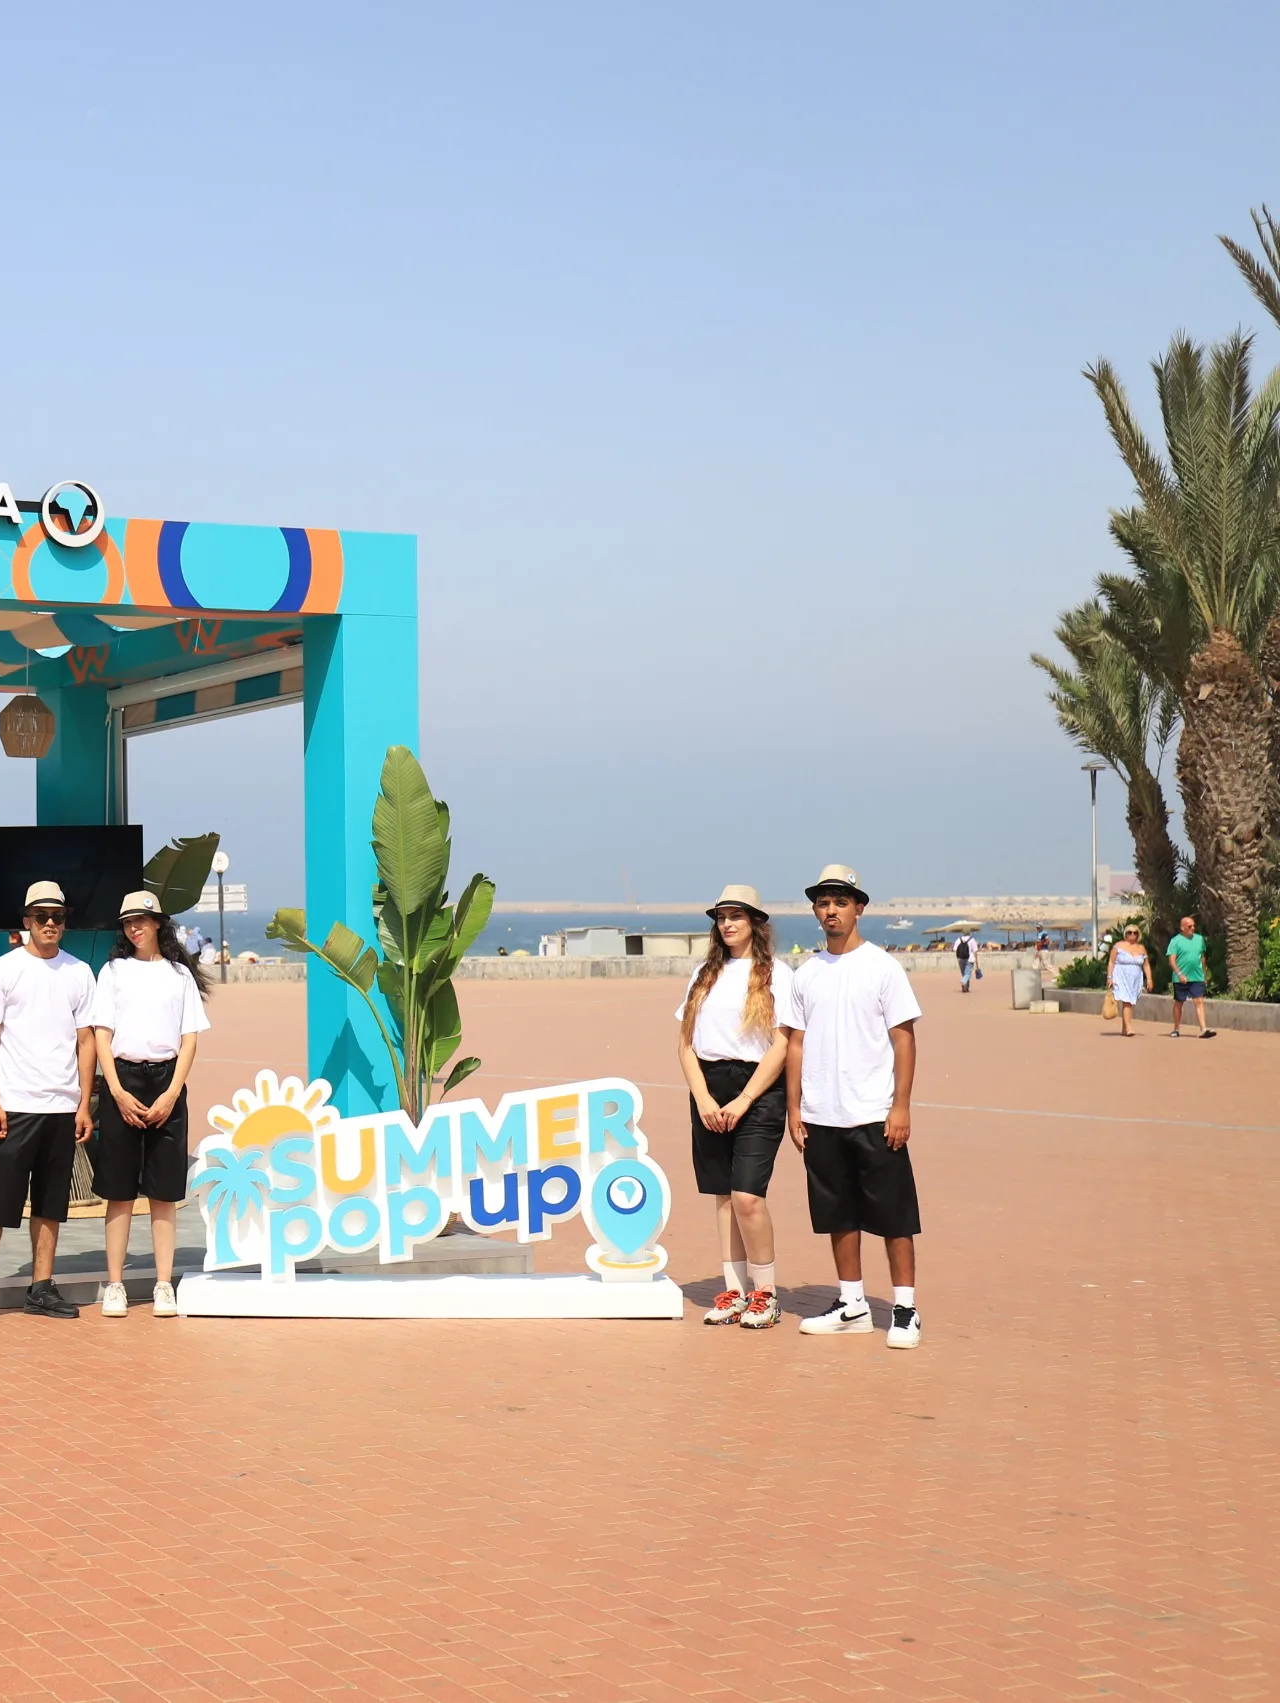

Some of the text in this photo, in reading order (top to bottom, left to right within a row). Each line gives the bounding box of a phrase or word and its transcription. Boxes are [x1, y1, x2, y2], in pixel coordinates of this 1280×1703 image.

[269, 1087, 640, 1203] SUMMER
[269, 1164, 581, 1275] pop up
